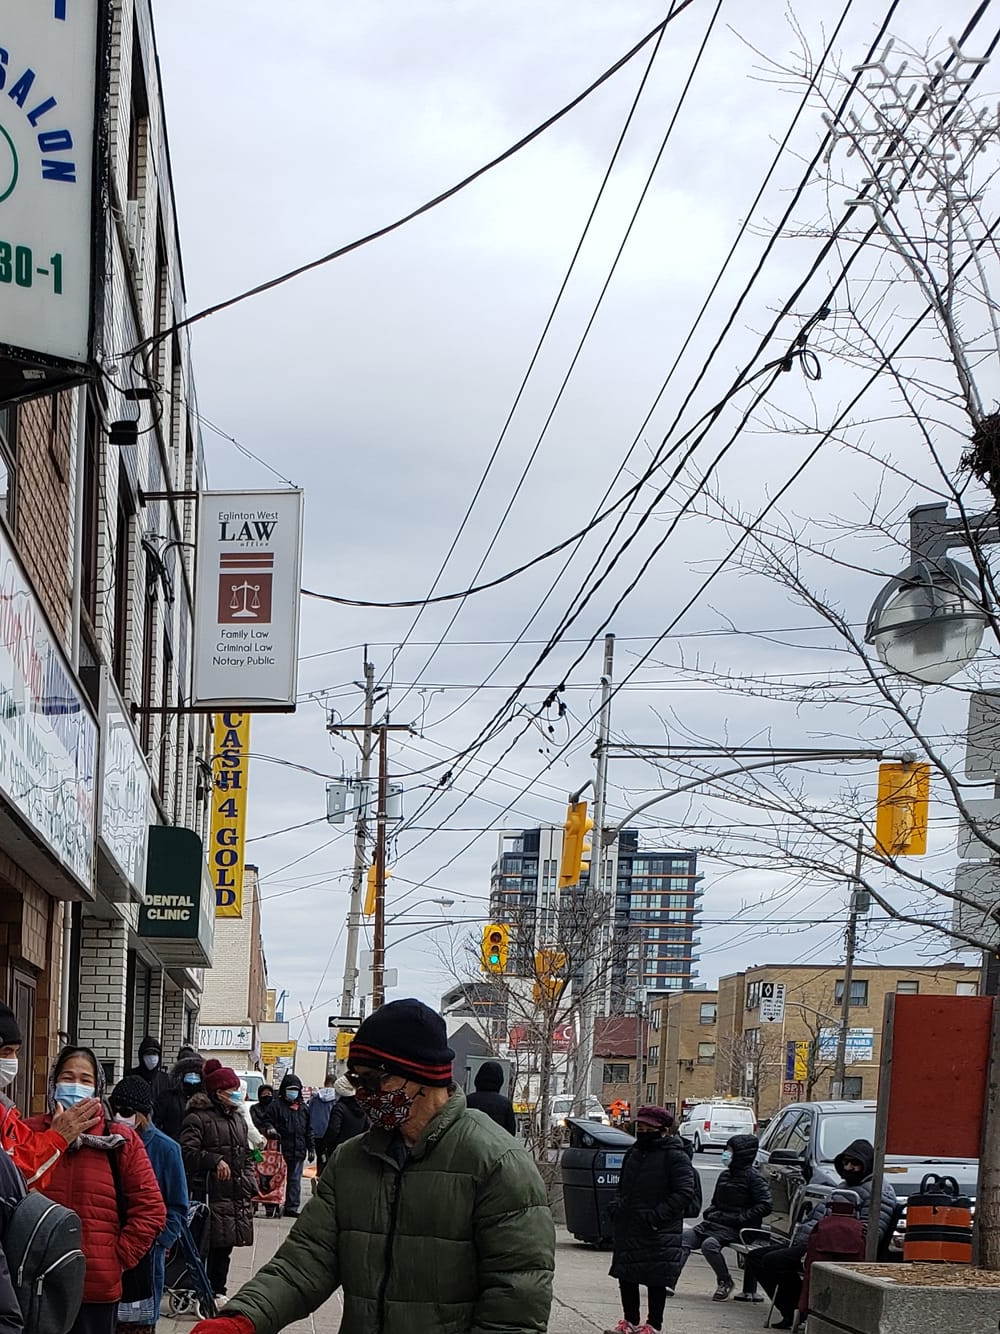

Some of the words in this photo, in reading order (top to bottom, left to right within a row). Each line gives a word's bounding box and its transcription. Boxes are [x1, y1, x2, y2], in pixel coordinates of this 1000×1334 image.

[219, 511, 255, 522] Eglinton
[257, 511, 278, 519] West
[218, 521, 278, 541] LAW
[221, 630, 249, 640] Family
[251, 630, 269, 638] Law
[216, 643, 252, 652] Criminal
[255, 643, 272, 651] Law
[213, 656, 244, 667] Notary
[247, 656, 275, 664] Public
[220, 713, 243, 789] CASH
[218, 799, 238, 818] 4
[215, 828, 239, 907] GOLD
[144, 895, 194, 906] DENTAL
[147, 909, 190, 920] CLINIC
